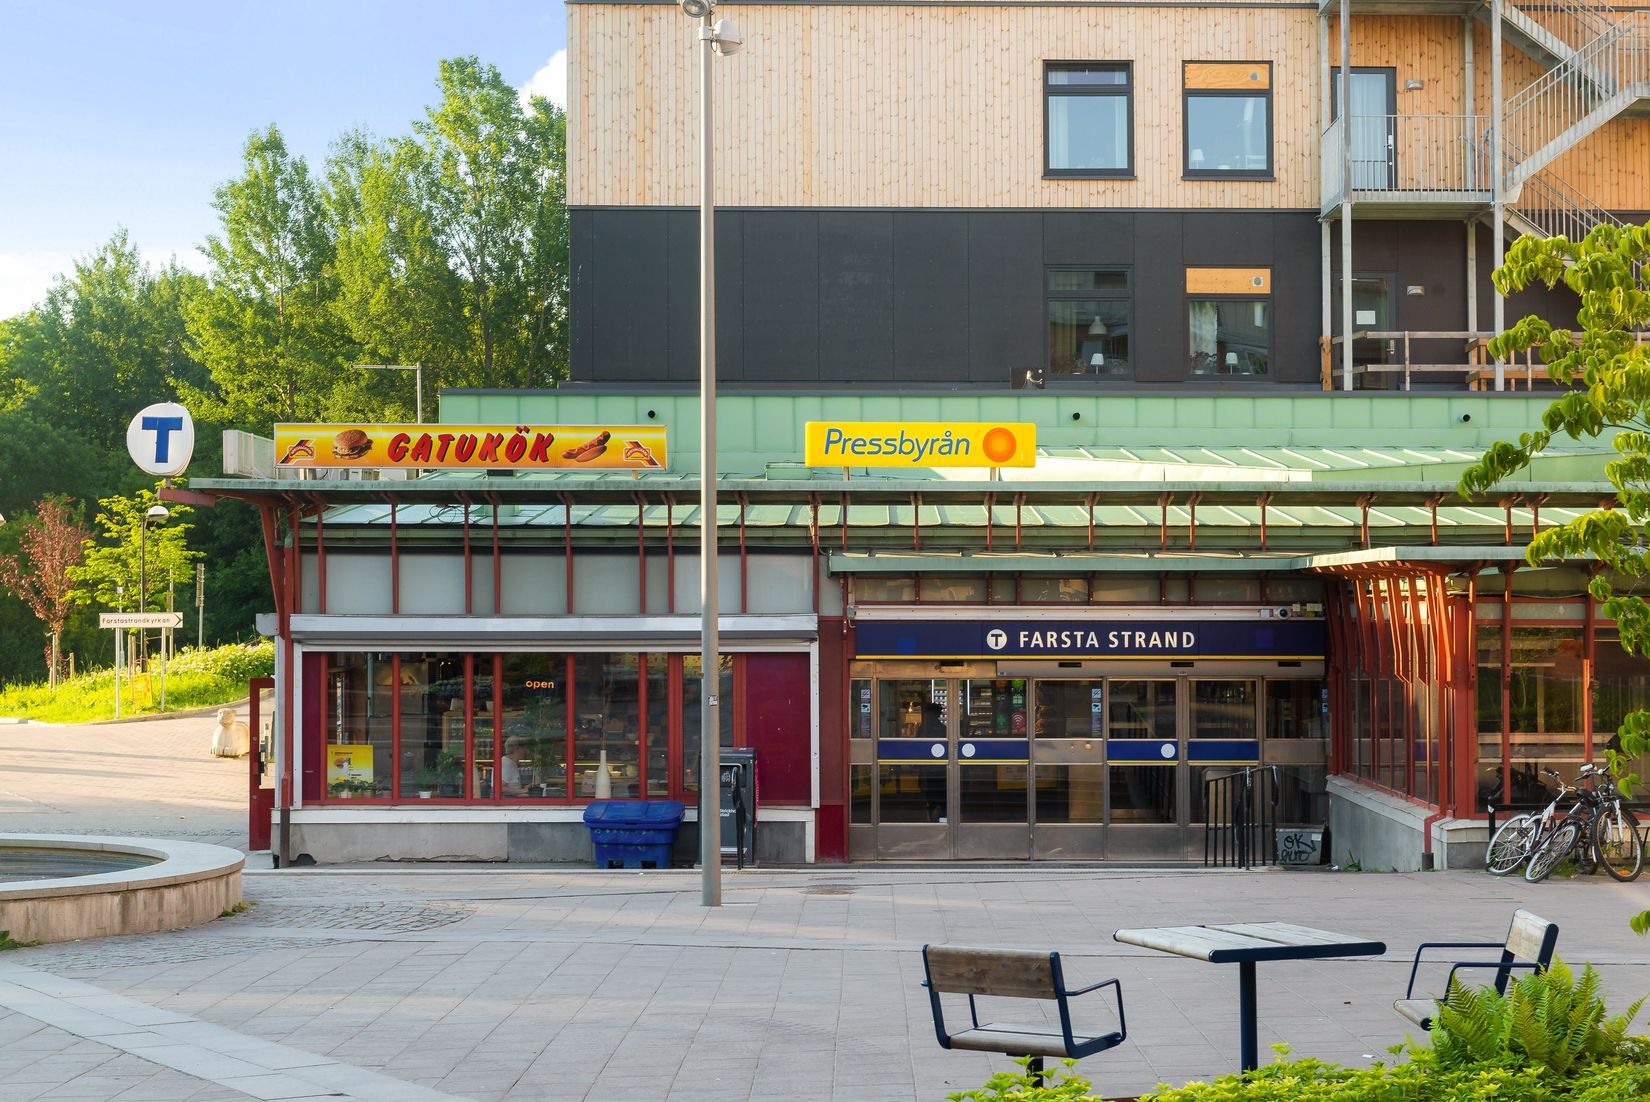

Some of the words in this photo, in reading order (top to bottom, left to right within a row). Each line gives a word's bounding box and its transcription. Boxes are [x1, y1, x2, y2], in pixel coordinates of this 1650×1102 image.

[142, 416, 183, 463] T
[387, 425, 555, 463] GATUKÖK
[824, 428, 971, 463] Pressbyrån
[1019, 631, 1099, 648] FARSTA
[1108, 631, 1195, 648] STRAND
[525, 680, 555, 689] open
